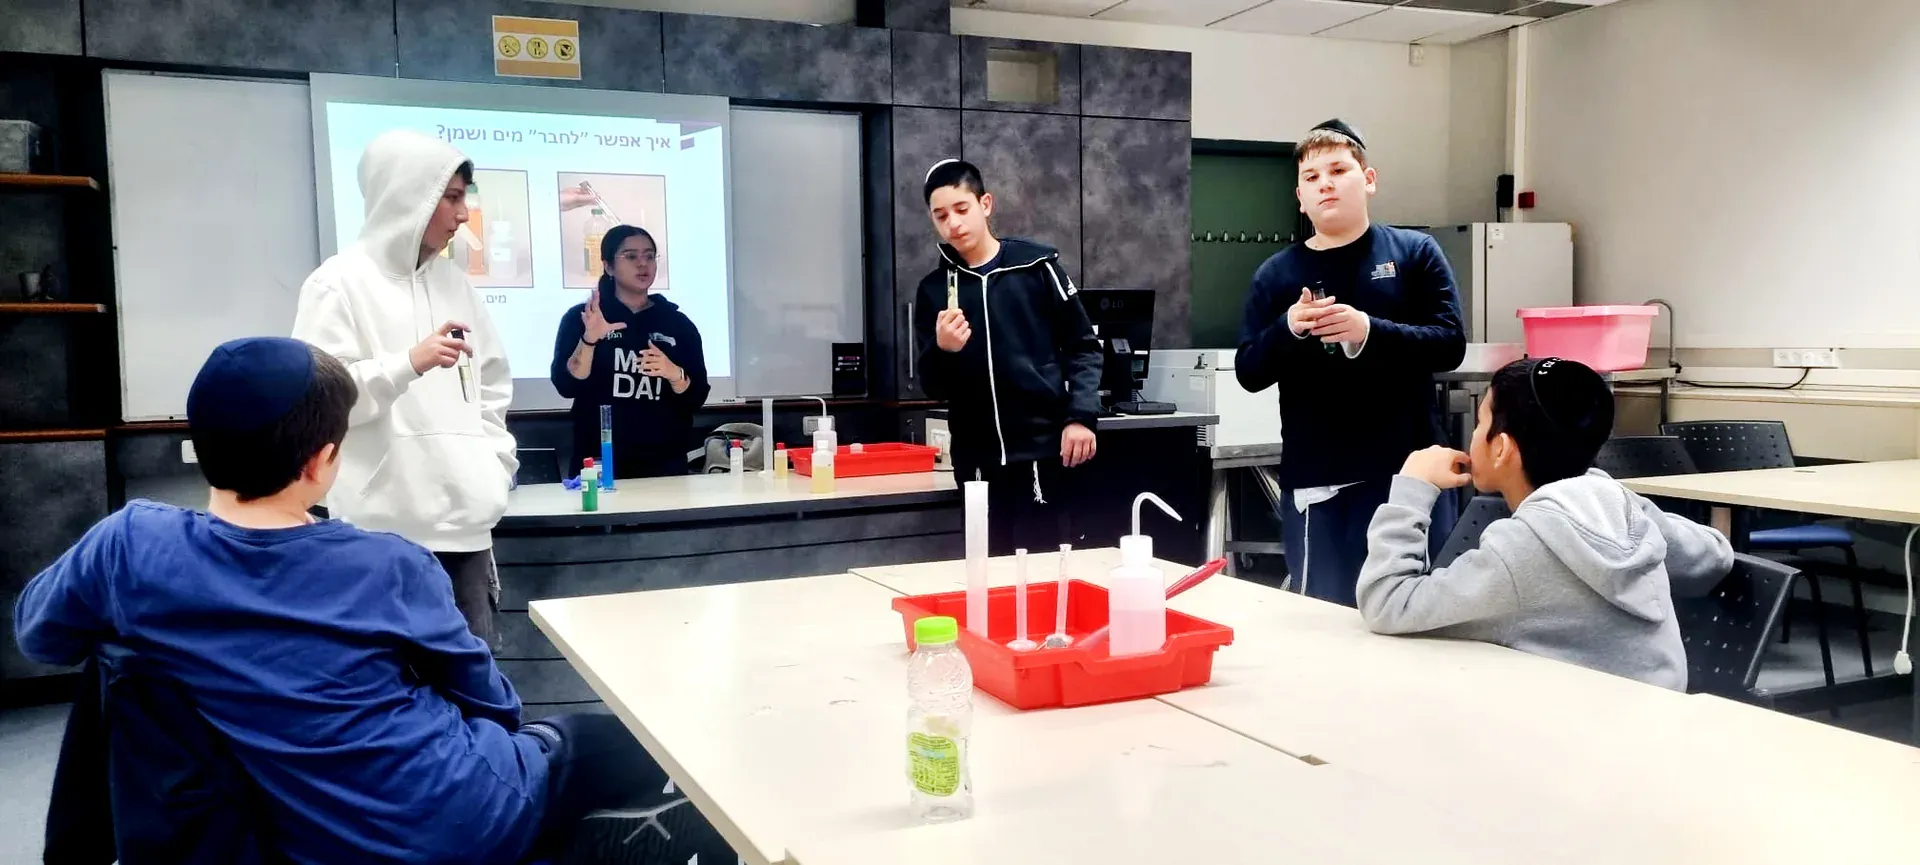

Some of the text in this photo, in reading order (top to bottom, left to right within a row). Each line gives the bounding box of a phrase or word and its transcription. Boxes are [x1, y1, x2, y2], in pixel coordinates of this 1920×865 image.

[436, 124, 487, 143] ושמן?
[493, 129, 523, 143] מים
[594, 133, 641, 148] אפשר
[645, 136, 671, 151] איך
[613, 373, 662, 400] DA!
